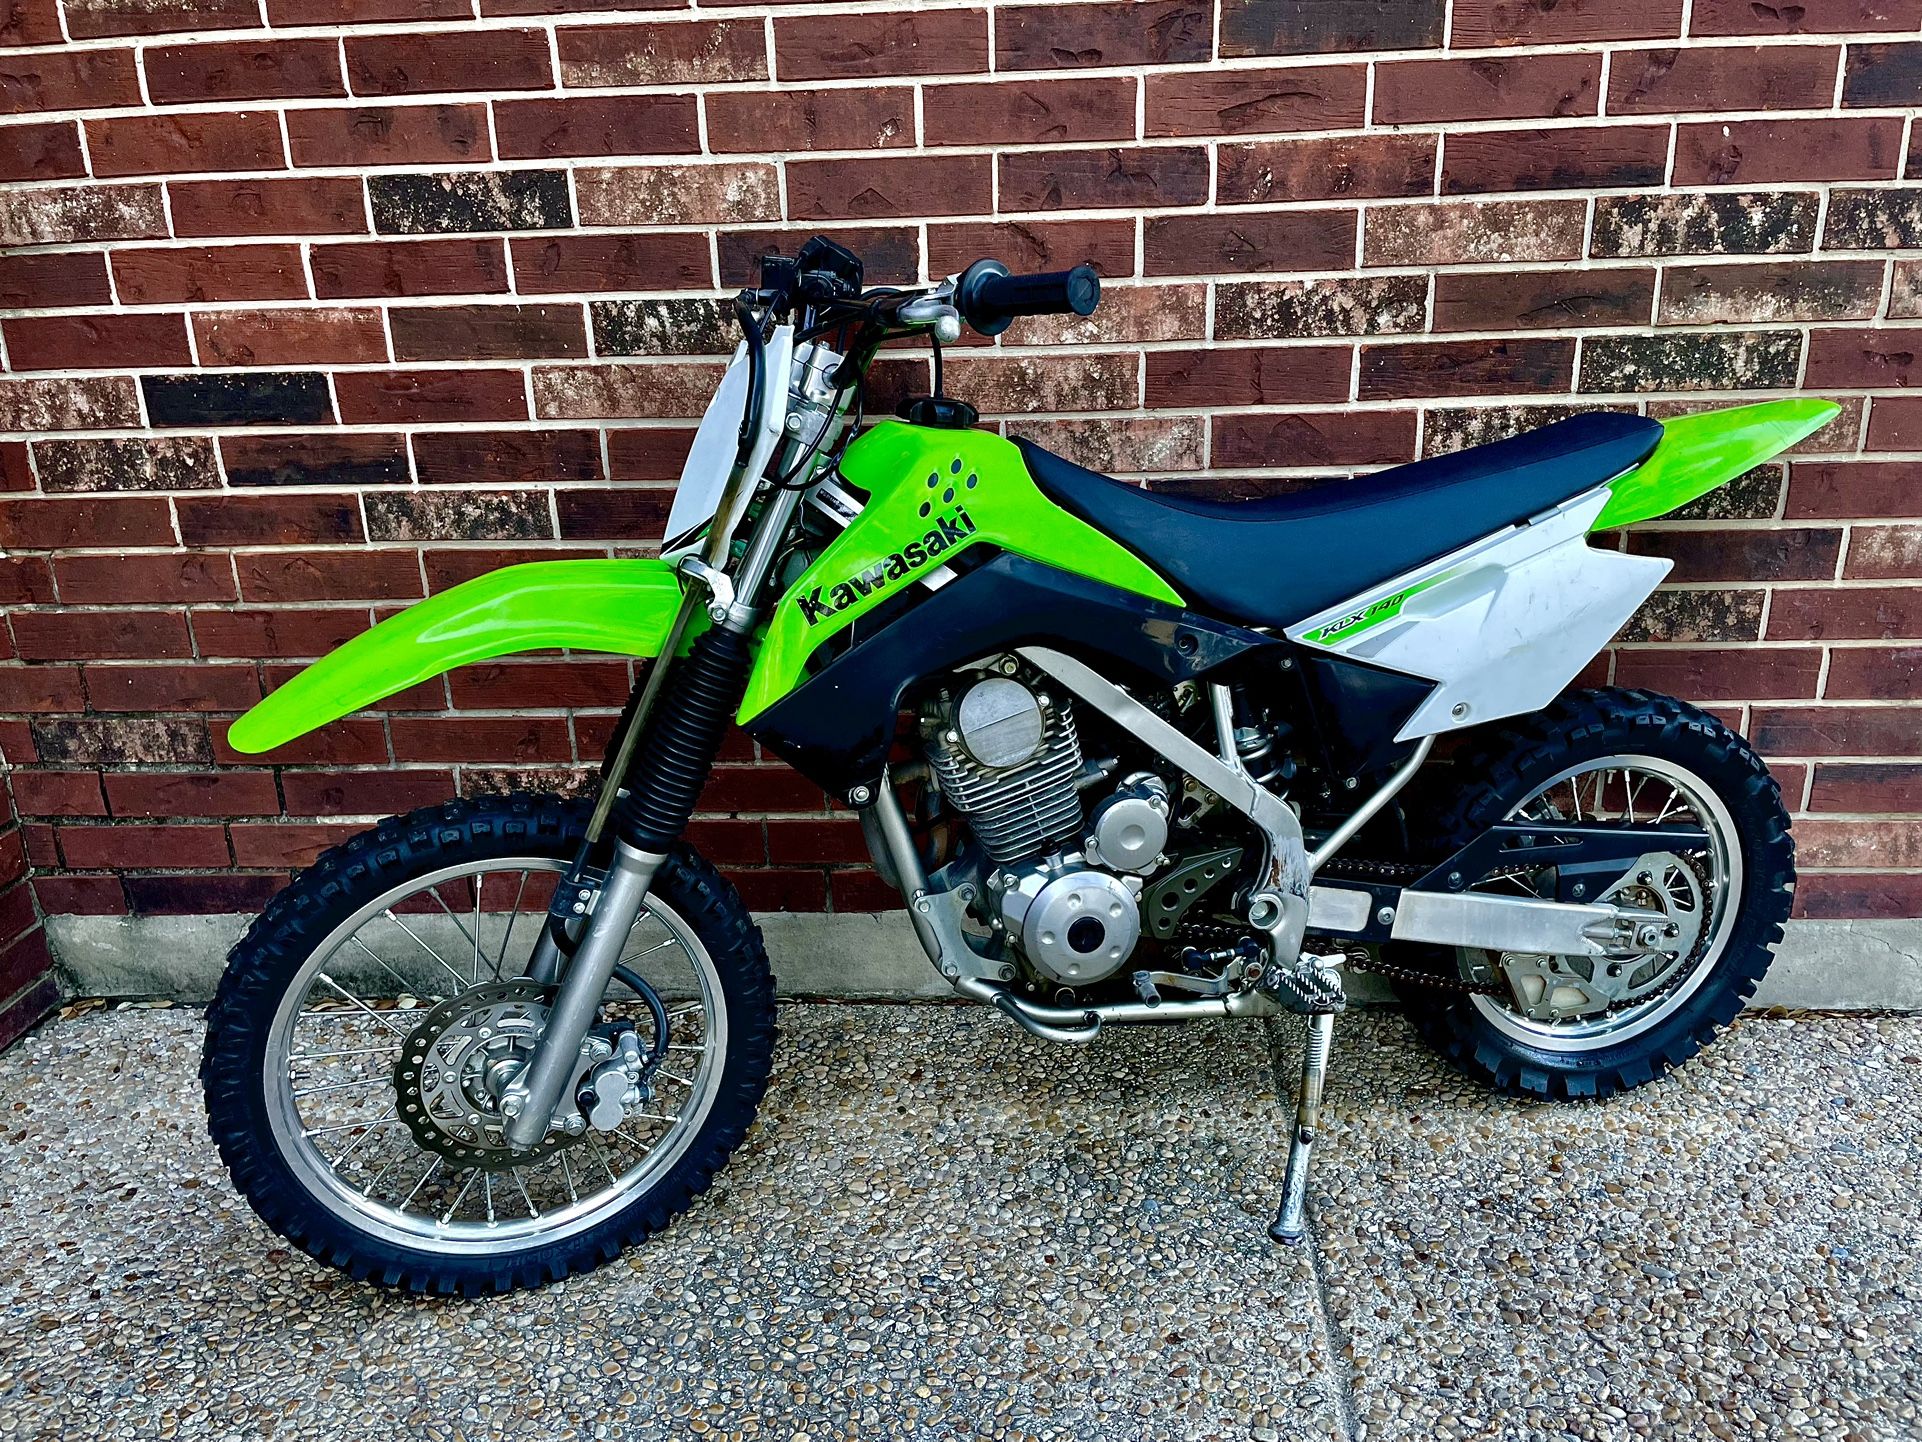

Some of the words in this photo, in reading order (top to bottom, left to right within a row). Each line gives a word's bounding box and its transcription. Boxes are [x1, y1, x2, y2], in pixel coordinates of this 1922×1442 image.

[796, 504, 977, 628] Kawasaki
[1320, 611, 1366, 639] KLX
[1370, 593, 1405, 616] 140
